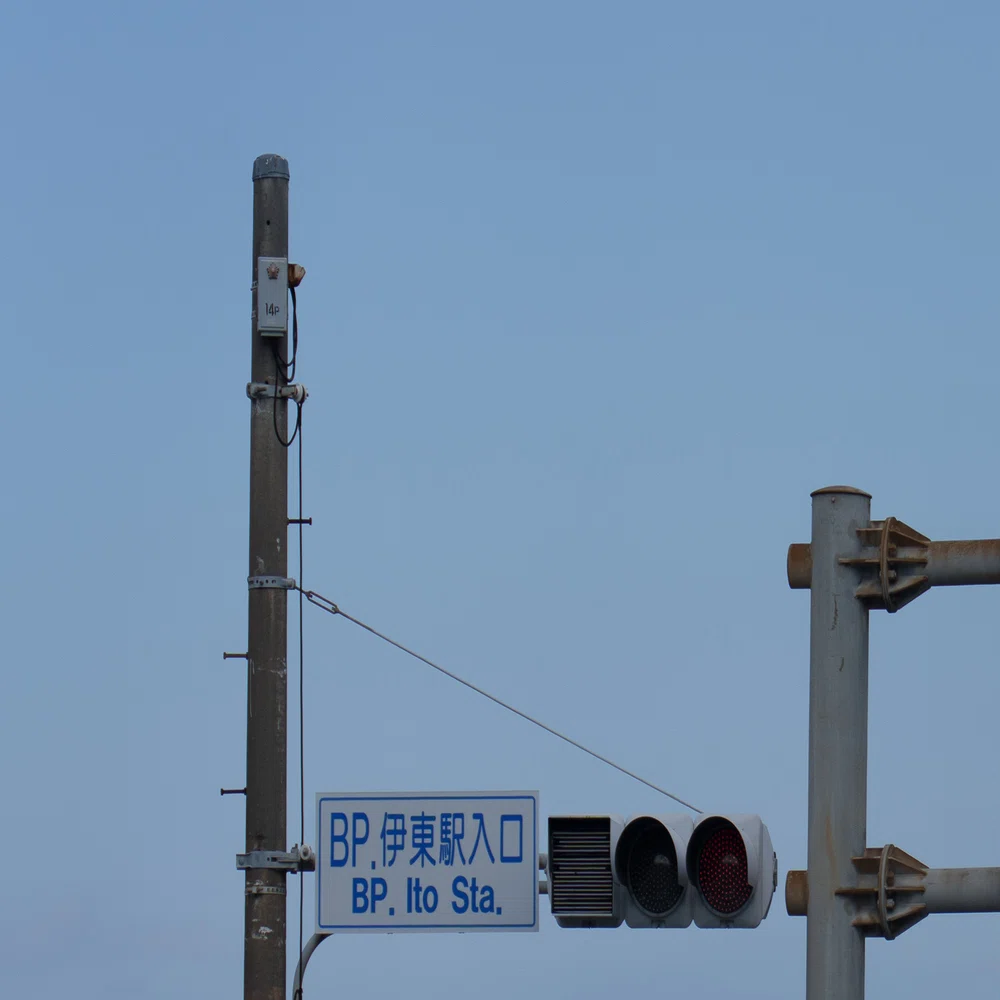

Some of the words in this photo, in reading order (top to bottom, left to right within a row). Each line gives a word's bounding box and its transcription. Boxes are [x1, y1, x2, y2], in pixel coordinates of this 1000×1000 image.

[351, 877, 395, 916] BP.
[406, 876, 439, 914] Ito
[451, 875, 502, 915] Sta.
